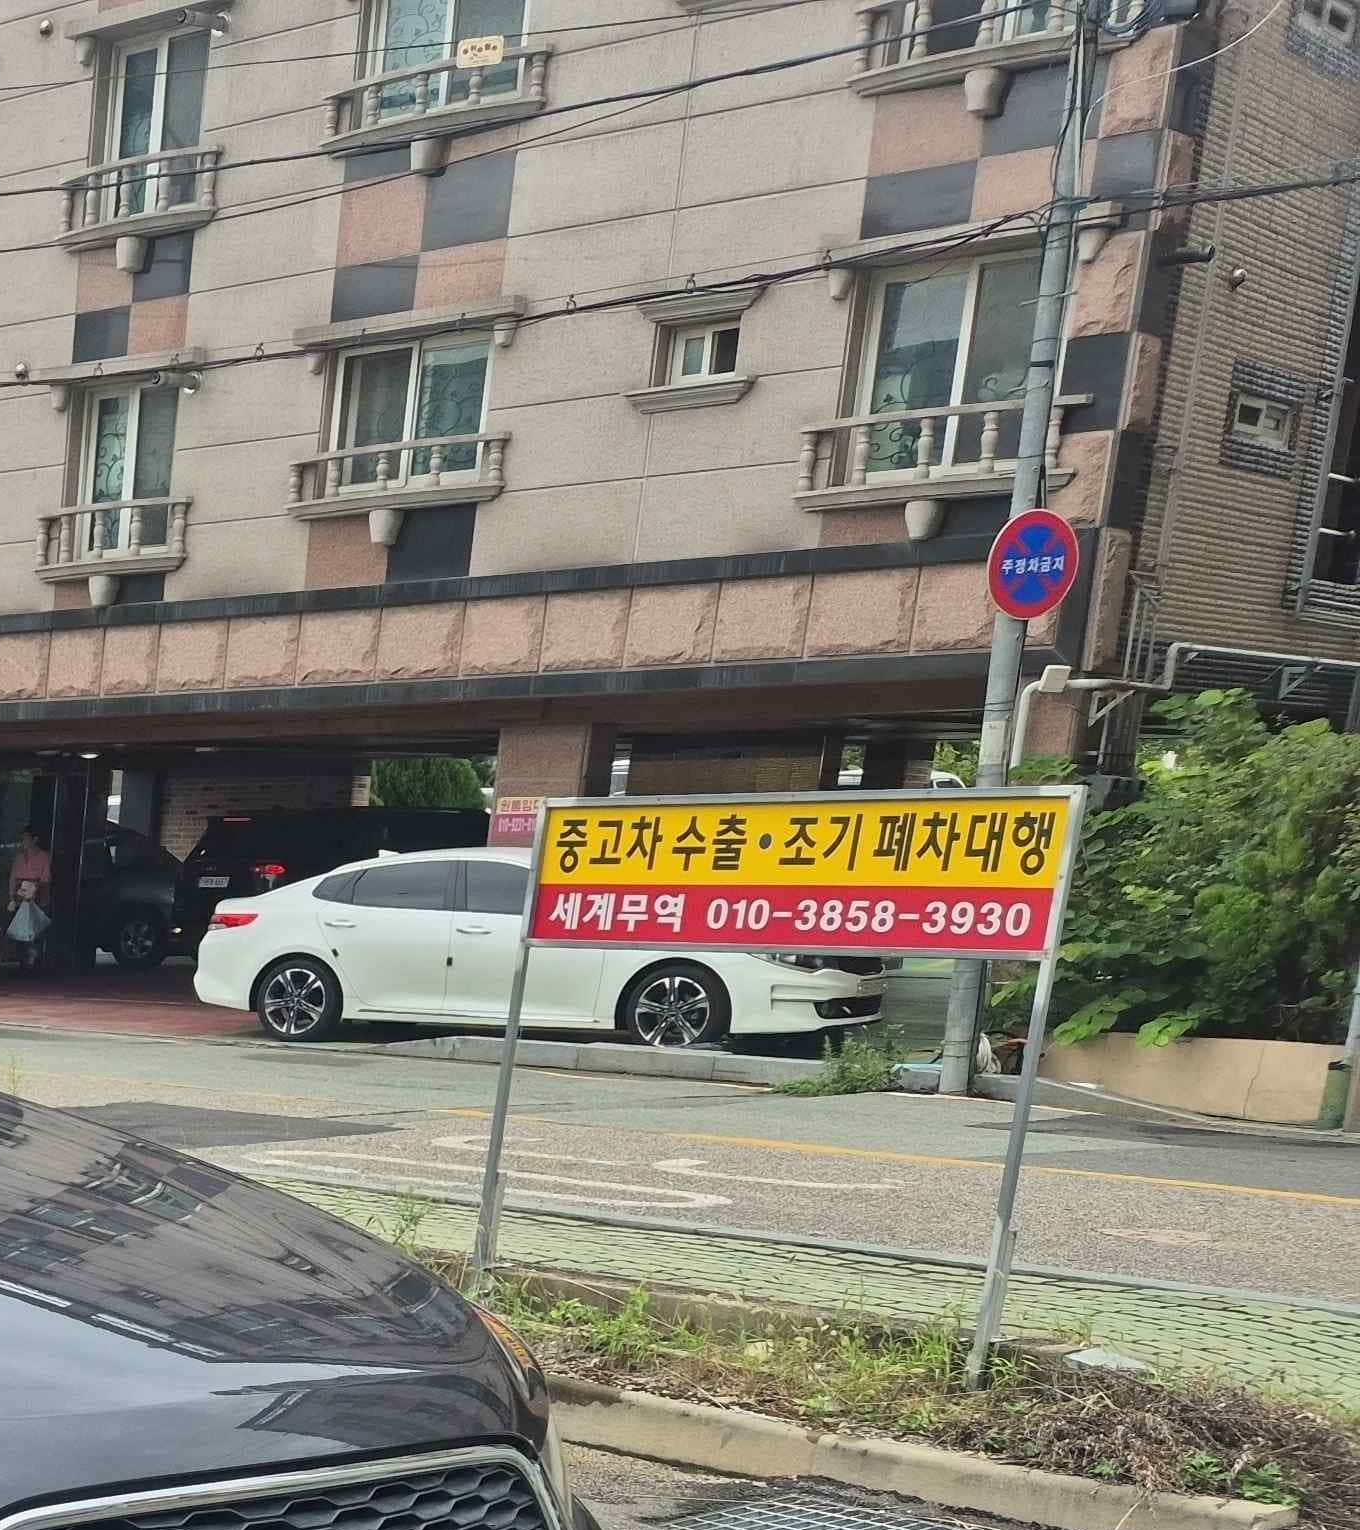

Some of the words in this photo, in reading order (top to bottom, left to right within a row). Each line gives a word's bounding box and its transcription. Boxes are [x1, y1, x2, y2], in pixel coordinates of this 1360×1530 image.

[1001, 555, 1064, 575] 주정차금지
[556, 816, 663, 873] 중고차
[872, 811, 1056, 876] 폐차대행
[549, 893, 685, 932] 세계무역
[706, 898, 1030, 936] 010-3858-3930
